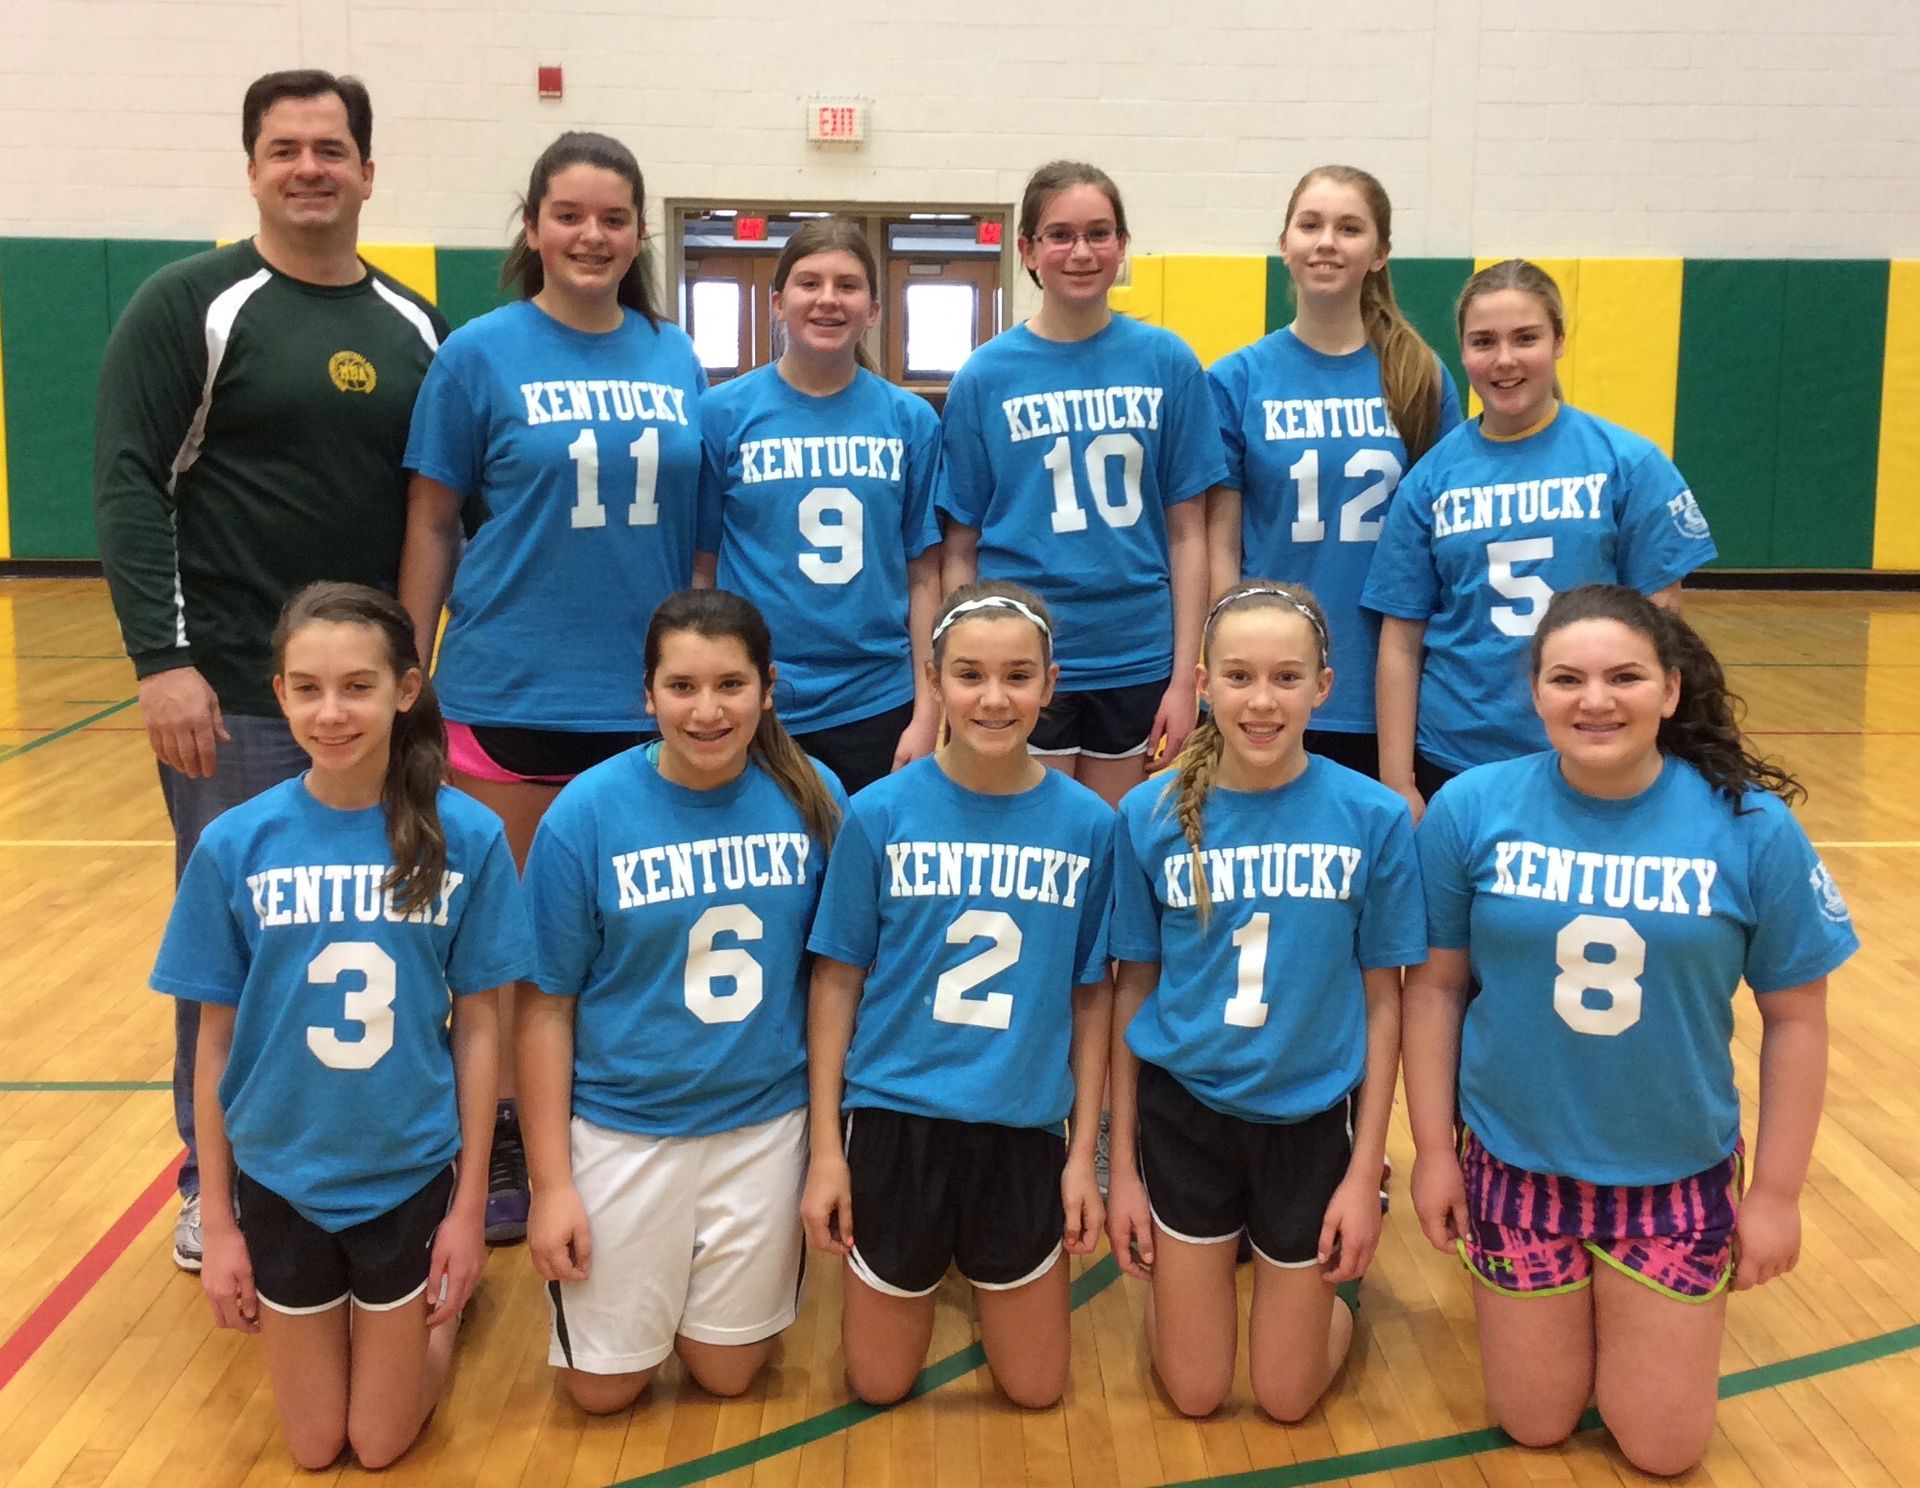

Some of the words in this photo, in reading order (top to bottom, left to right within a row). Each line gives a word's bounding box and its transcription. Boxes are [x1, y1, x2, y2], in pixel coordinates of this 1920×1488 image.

[819, 106, 855, 137] EXIT
[520, 380, 688, 426] KENTUCKY
[1002, 386, 1164, 442] KENTUCKY
[1262, 396, 1401, 441] KENTUC
[568, 427, 660, 528] 11
[740, 435, 904, 484] KENTUCKY
[1043, 433, 1144, 533] 10
[1290, 448, 1403, 542] 12
[1432, 473, 1608, 538] KENTUCKY
[798, 487, 864, 584] 9
[1486, 536, 1555, 637] 5
[611, 832, 810, 910] KENTUCKY
[885, 841, 1091, 908] KENTUCKY
[1490, 840, 1718, 917] KENTUCKY
[306, 941, 396, 1070] 3
[684, 903, 763, 1024] 6
[933, 909, 1023, 1030] 2
[1224, 911, 1270, 1028] 1
[1553, 913, 1647, 1037] 8
